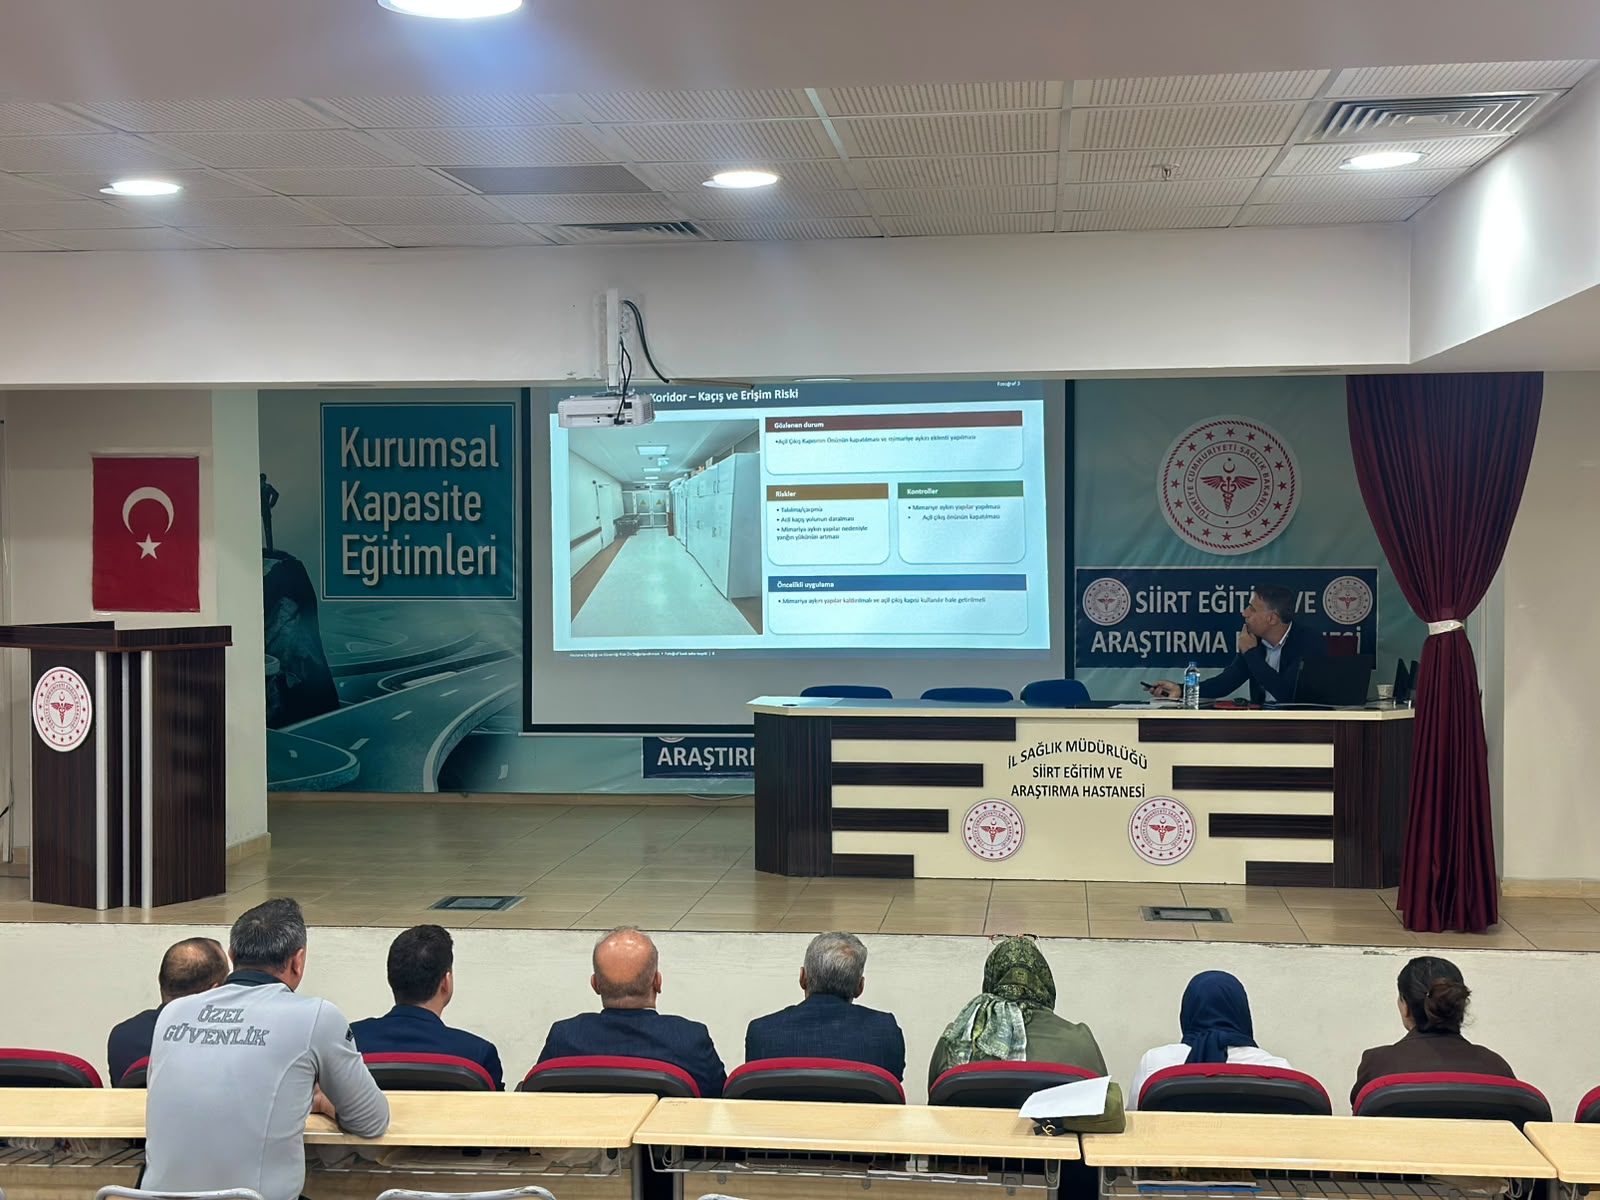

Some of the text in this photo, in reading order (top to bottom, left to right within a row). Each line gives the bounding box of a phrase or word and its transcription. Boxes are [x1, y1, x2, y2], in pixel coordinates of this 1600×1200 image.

[650, 391, 688, 403] Koridor
[698, 391, 724, 404] Kaçış
[726, 392, 739, 401] ve
[741, 389, 772, 402] Erişim
[774, 388, 799, 400] Riski
[774, 421, 803, 429] Gözlenen
[341, 424, 499, 468] Kurumsal
[1239, 445, 1266, 471] SAĞLIK
[1188, 443, 1238, 483] CUMHURİYETİ
[775, 490, 797, 498] Riskler
[906, 487, 939, 495] Kontroller
[1247, 472, 1271, 519] BAKANLIĞI
[341, 480, 482, 532] Kapasite
[342, 532, 497, 587] Eğitimleri
[777, 580, 835, 590] Öncelikli uygulama
[1135, 585, 1191, 614] SİİRT
[1091, 630, 1229, 659] ARAŞTIRMA
[657, 746, 755, 771] ARAŞTIR
[1007, 737, 1148, 770] İL SAĞLIK MÜDÜRLÜĞÜ
[1032, 763, 1123, 779] SİİRT EĞİTİM VE
[1010, 783, 1146, 800] ARAŞTIRMA HASTANESİ
[197, 1004, 245, 1024] ÖZEL
[163, 1022, 271, 1047] GÜVENLİK
